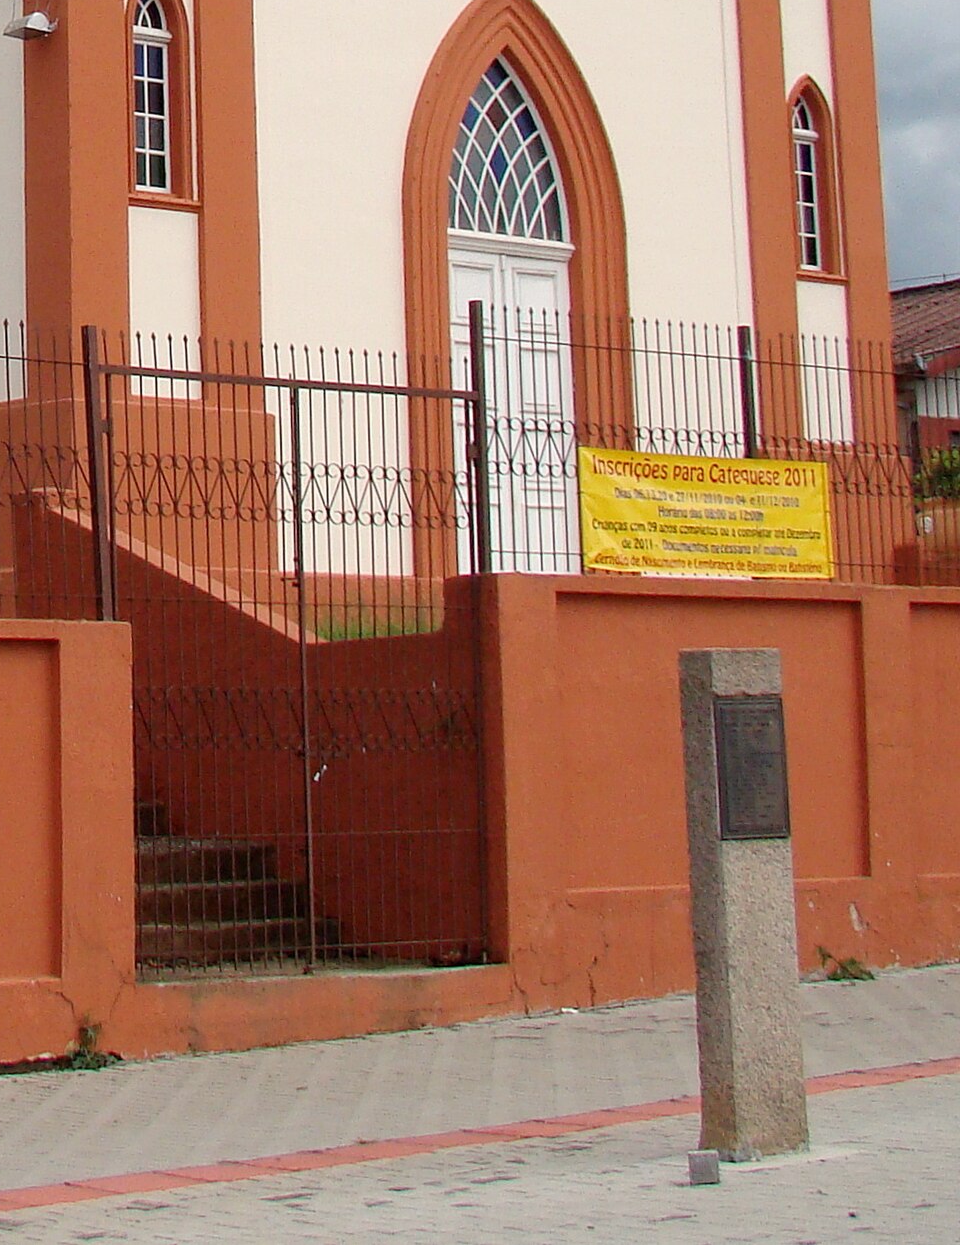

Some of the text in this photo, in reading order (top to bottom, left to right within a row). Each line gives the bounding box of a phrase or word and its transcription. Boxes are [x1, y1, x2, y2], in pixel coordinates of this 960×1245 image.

[592, 455, 815, 486] Inscrições para Catequese 2011
[615, 487, 631, 499] Dias
[592, 518, 627, 532] Crianças
[659, 525, 677, 533] anos
[680, 526, 718, 535] completos
[622, 539, 631, 548] de
[634, 539, 653, 549] 2011
[662, 540, 708, 553] Documentos
[631, 556, 640, 565] de
[736, 561, 745, 570] de
